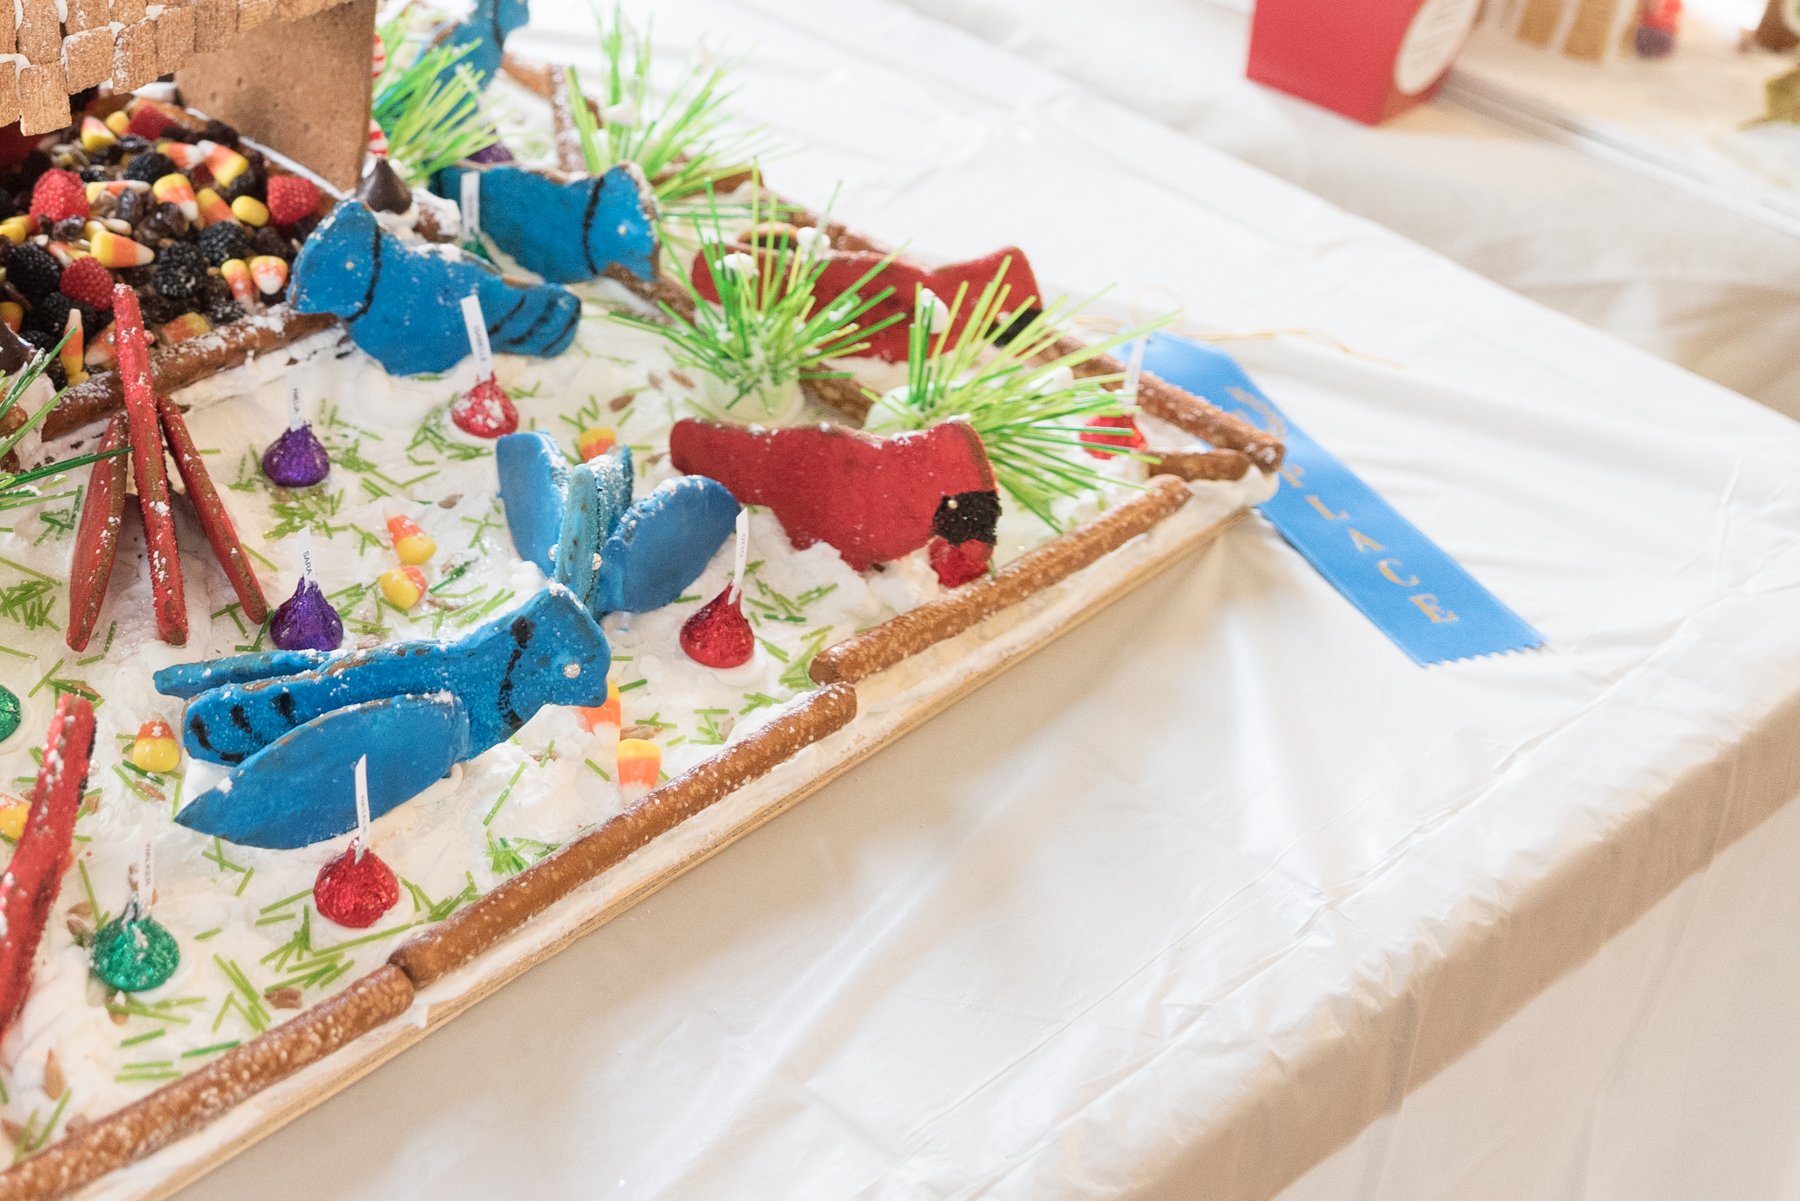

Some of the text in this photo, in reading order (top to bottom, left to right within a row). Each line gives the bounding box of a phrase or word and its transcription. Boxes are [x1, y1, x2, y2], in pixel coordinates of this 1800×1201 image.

[302, 550, 312, 576] SARA
[1278, 462, 1459, 623] PLACE
[144, 840, 153, 887] WALKER
